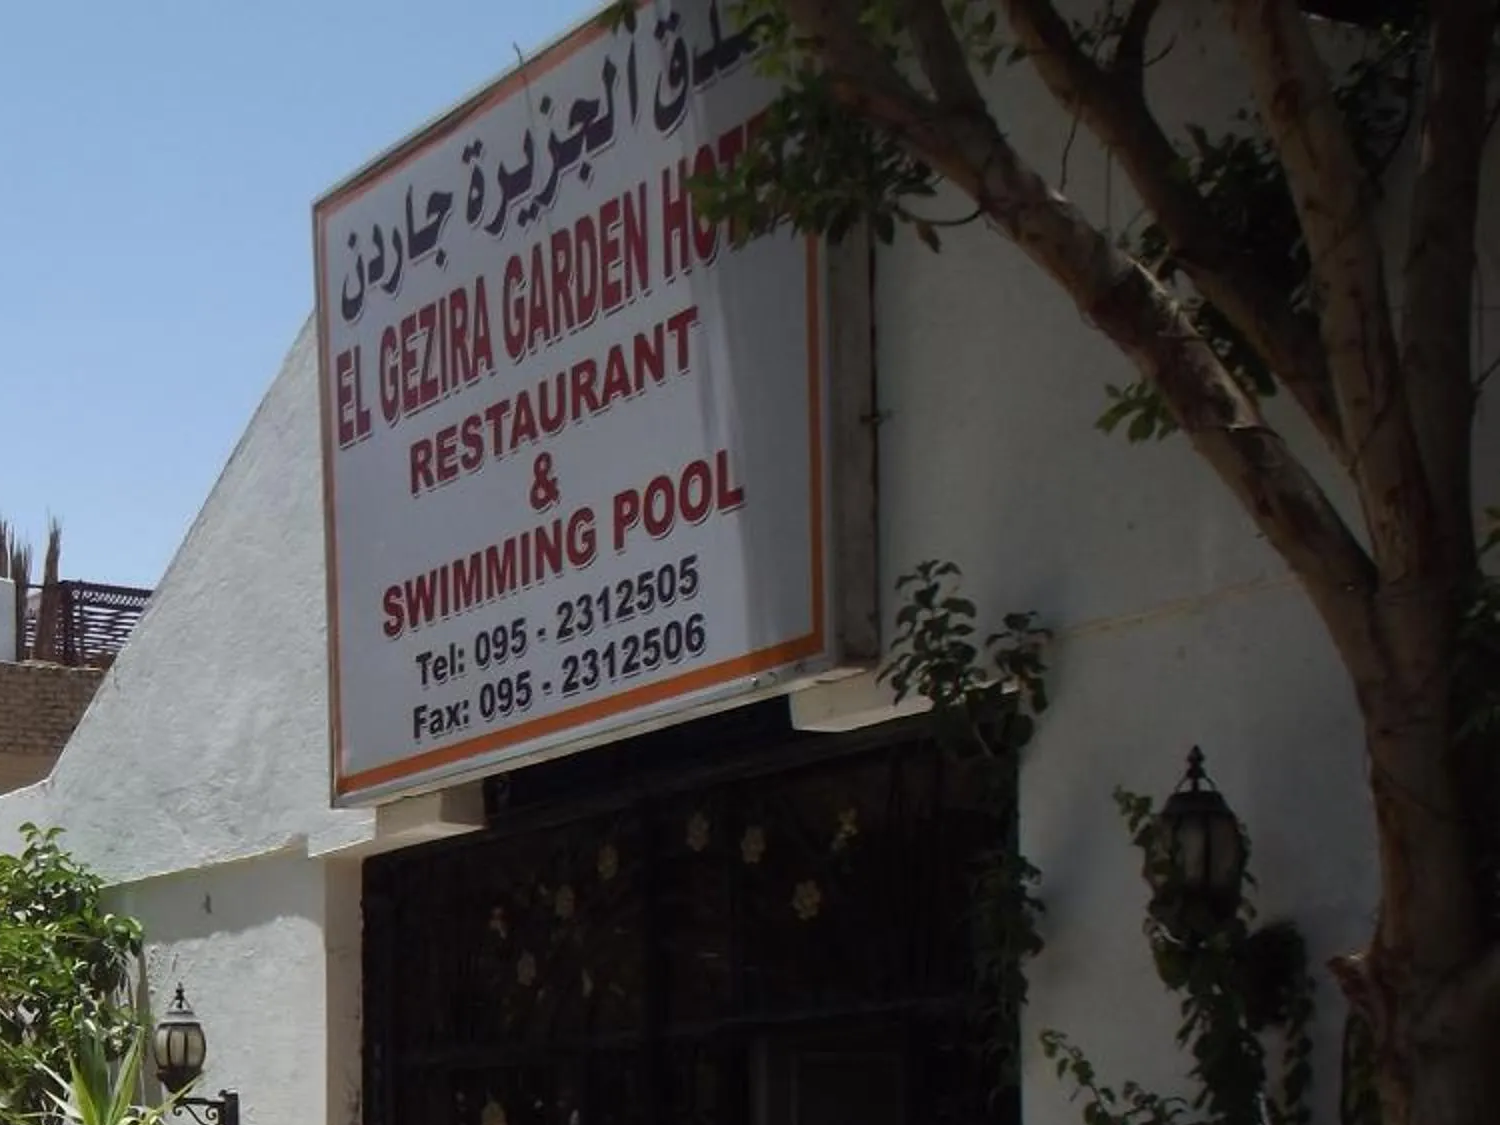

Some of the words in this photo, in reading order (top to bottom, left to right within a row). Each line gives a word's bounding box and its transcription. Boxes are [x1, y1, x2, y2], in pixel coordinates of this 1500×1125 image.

[461, 37, 638, 236] الجزيرة
[336, 345, 371, 446] EL
[379, 276, 493, 423] GEZIRA
[503, 181, 649, 359] GARDEN
[341, 184, 453, 322] جاردن
[409, 305, 699, 494] RESTAURANT
[529, 451, 560, 511] &
[383, 507, 597, 638] SWIMMING
[612, 449, 744, 551] POOL
[415, 643, 465, 686] Tel:
[474, 617, 527, 668] 095
[556, 554, 700, 641] 2312505
[413, 699, 470, 740] Fax:
[479, 670, 533, 719] 095
[561, 612, 706, 694] 2312506
